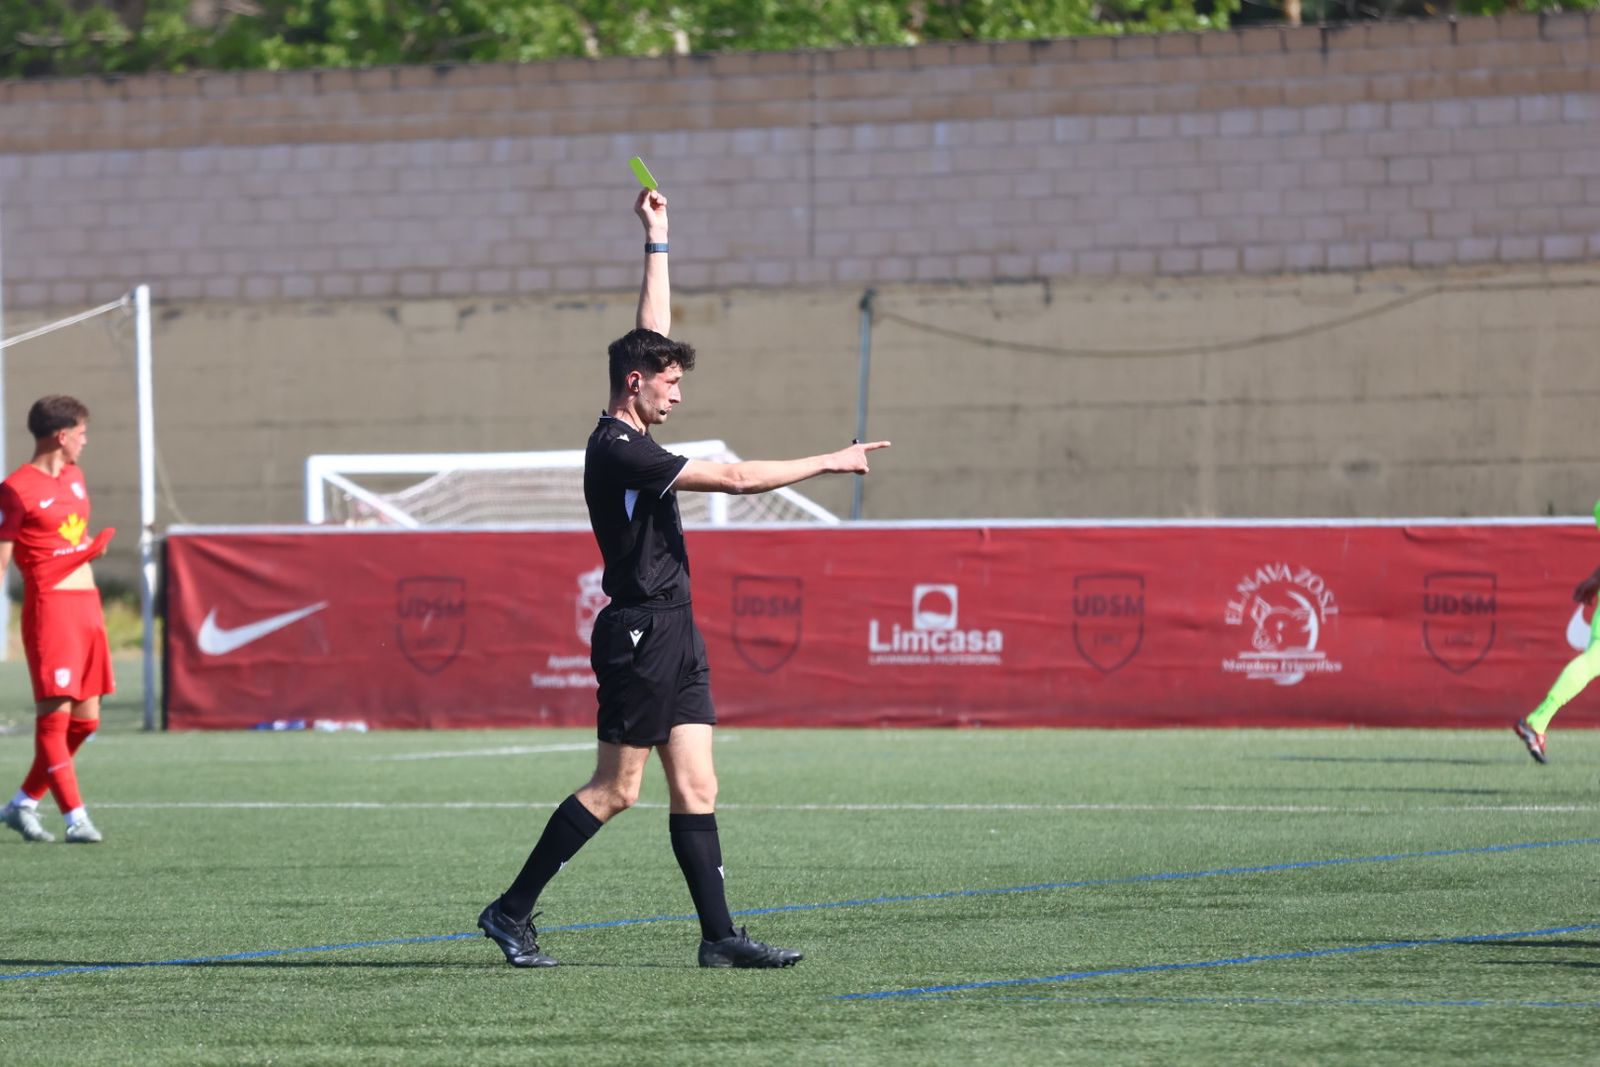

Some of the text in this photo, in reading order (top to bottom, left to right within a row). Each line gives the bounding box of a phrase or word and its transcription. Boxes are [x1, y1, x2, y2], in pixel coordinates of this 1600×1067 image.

[733, 596, 802, 617] UDSM
[1073, 595, 1144, 617] UDSM
[1424, 593, 1496, 615] UDSM
[868, 618, 1004, 653] Limcasa
